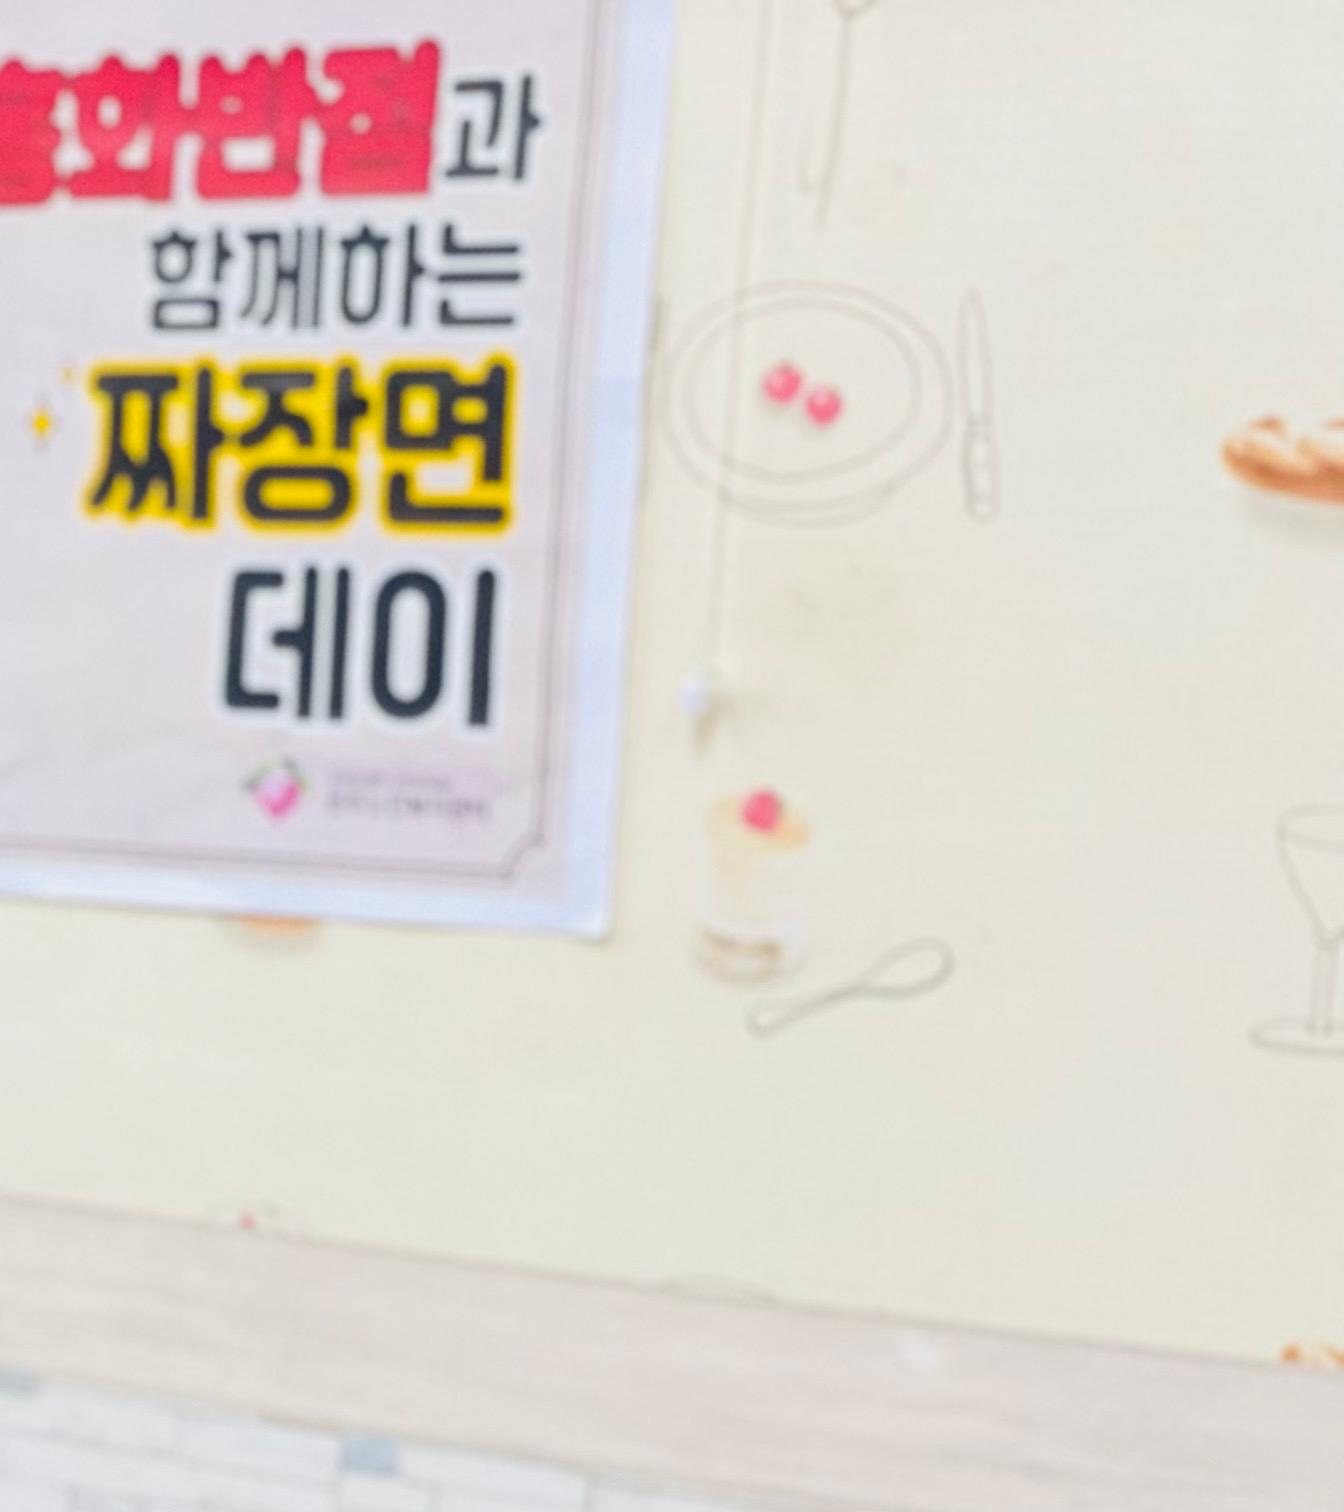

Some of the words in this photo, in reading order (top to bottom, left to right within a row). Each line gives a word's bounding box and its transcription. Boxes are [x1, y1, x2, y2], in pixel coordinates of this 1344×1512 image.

[151, 223, 521, 330] 함께하는
[86, 361, 511, 526] 짜장면
[223, 566, 496, 728] 데이
